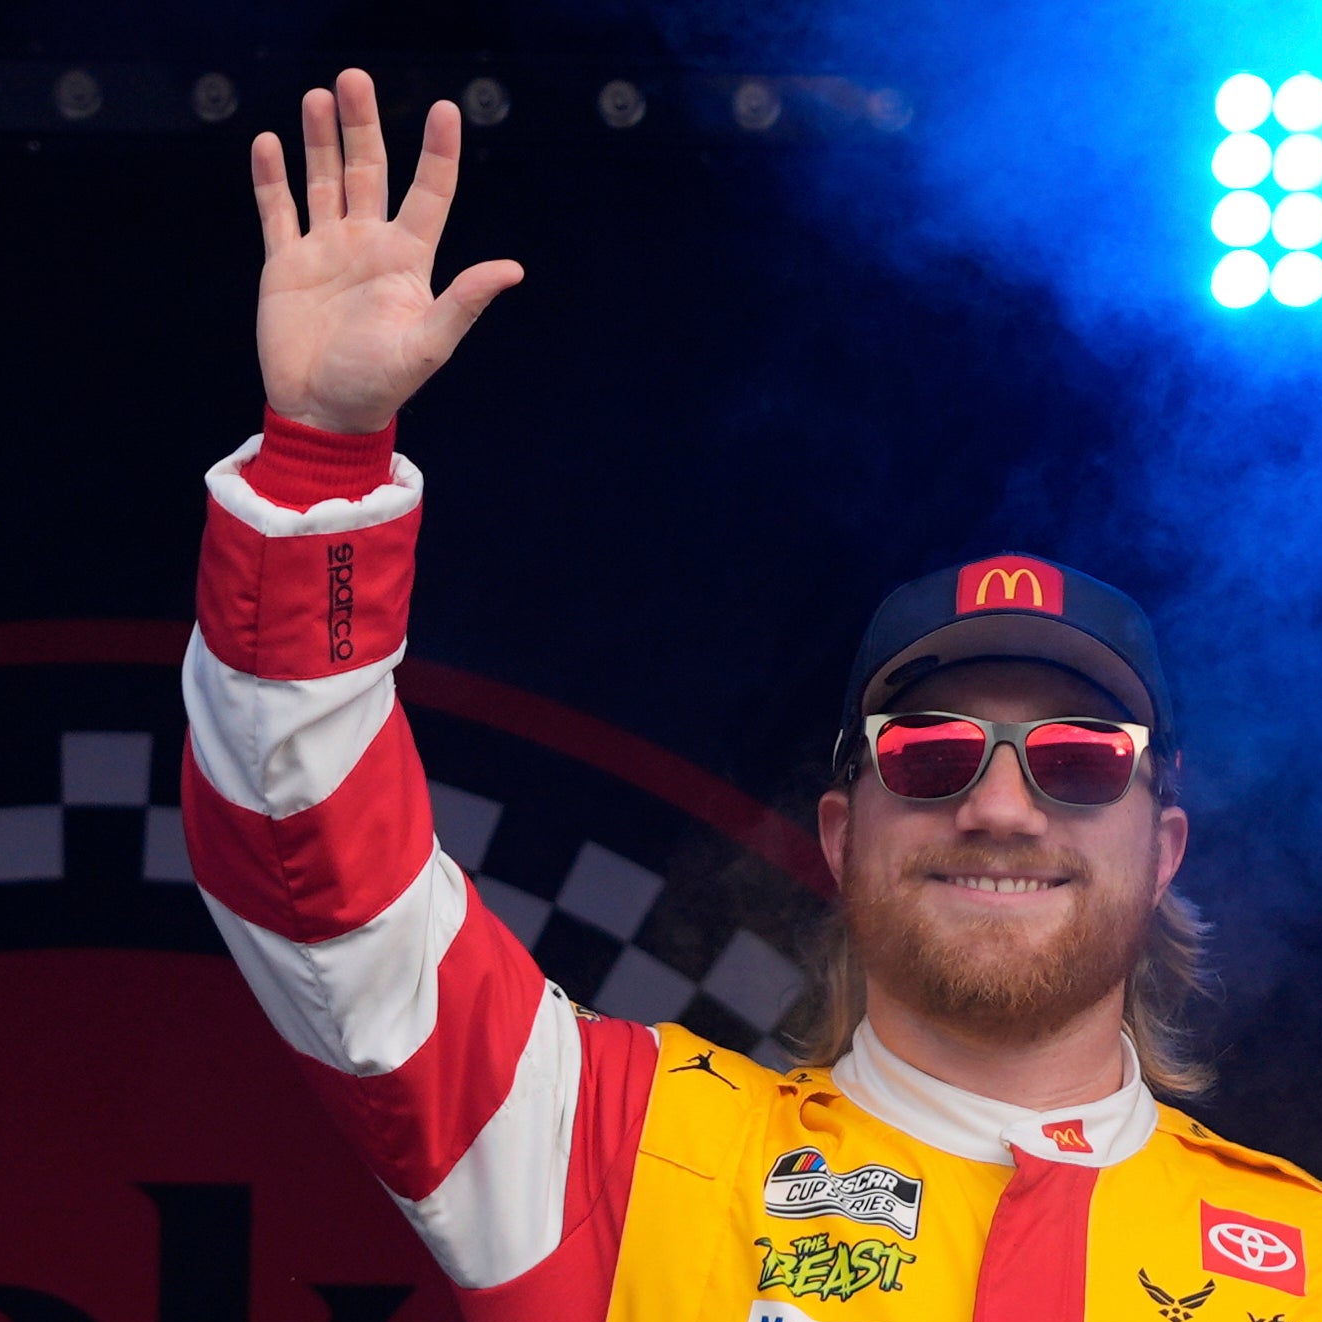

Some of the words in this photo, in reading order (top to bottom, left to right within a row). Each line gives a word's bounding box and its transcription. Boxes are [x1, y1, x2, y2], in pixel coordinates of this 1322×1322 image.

[327, 543, 354, 662] sparco
[786, 1180, 827, 1201] CUP
[830, 1170, 898, 1193] SCAR
[790, 1232, 829, 1257] THE
[754, 1239, 916, 1302] BEAST
